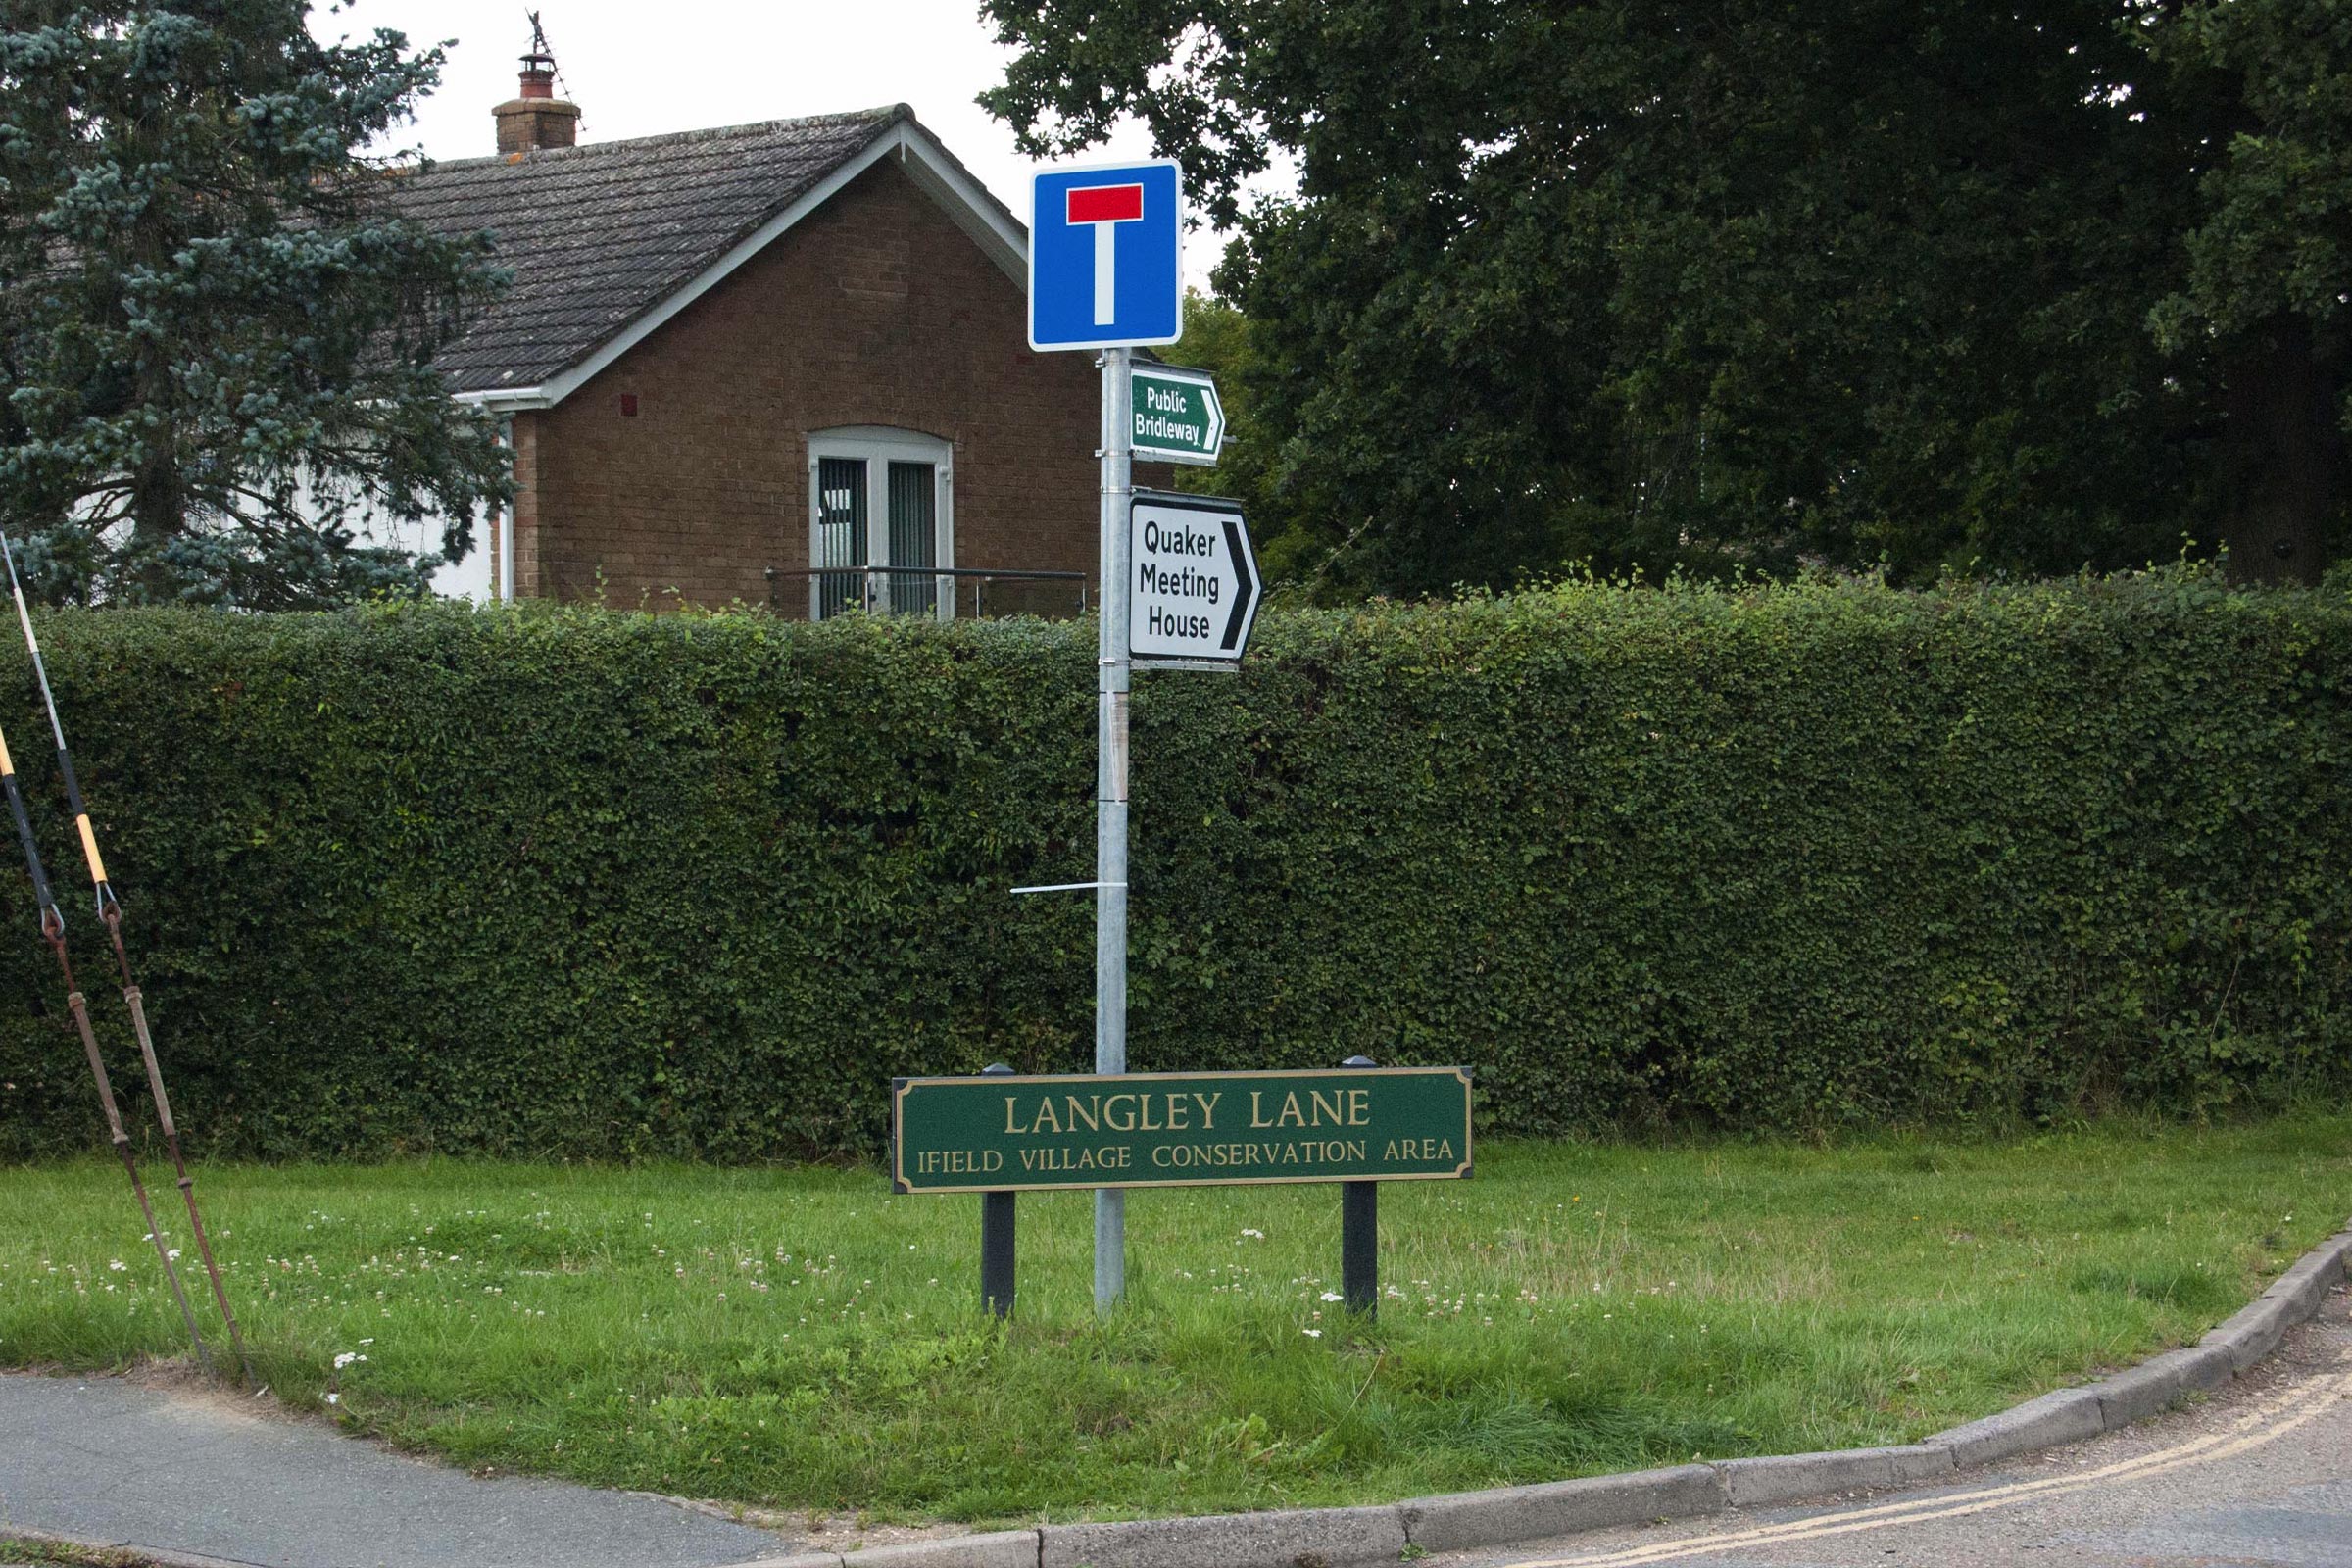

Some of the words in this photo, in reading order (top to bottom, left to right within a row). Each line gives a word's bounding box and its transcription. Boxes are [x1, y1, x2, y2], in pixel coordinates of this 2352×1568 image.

[1147, 386, 1187, 413] Public
[1135, 414, 1200, 445] Bridleway
[1144, 520, 1216, 557] Quaker
[1140, 563, 1219, 604] Meeting
[1149, 606, 1210, 639] House
[1004, 1092, 1222, 1134] LANGLEY
[1250, 1089, 1370, 1128] LANE
[918, 1150, 1003, 1173] IFIELD
[1019, 1146, 1131, 1170] VILLAGE
[1152, 1140, 1366, 1167] CONSERVATION
[1384, 1138, 1454, 1160] AREA
